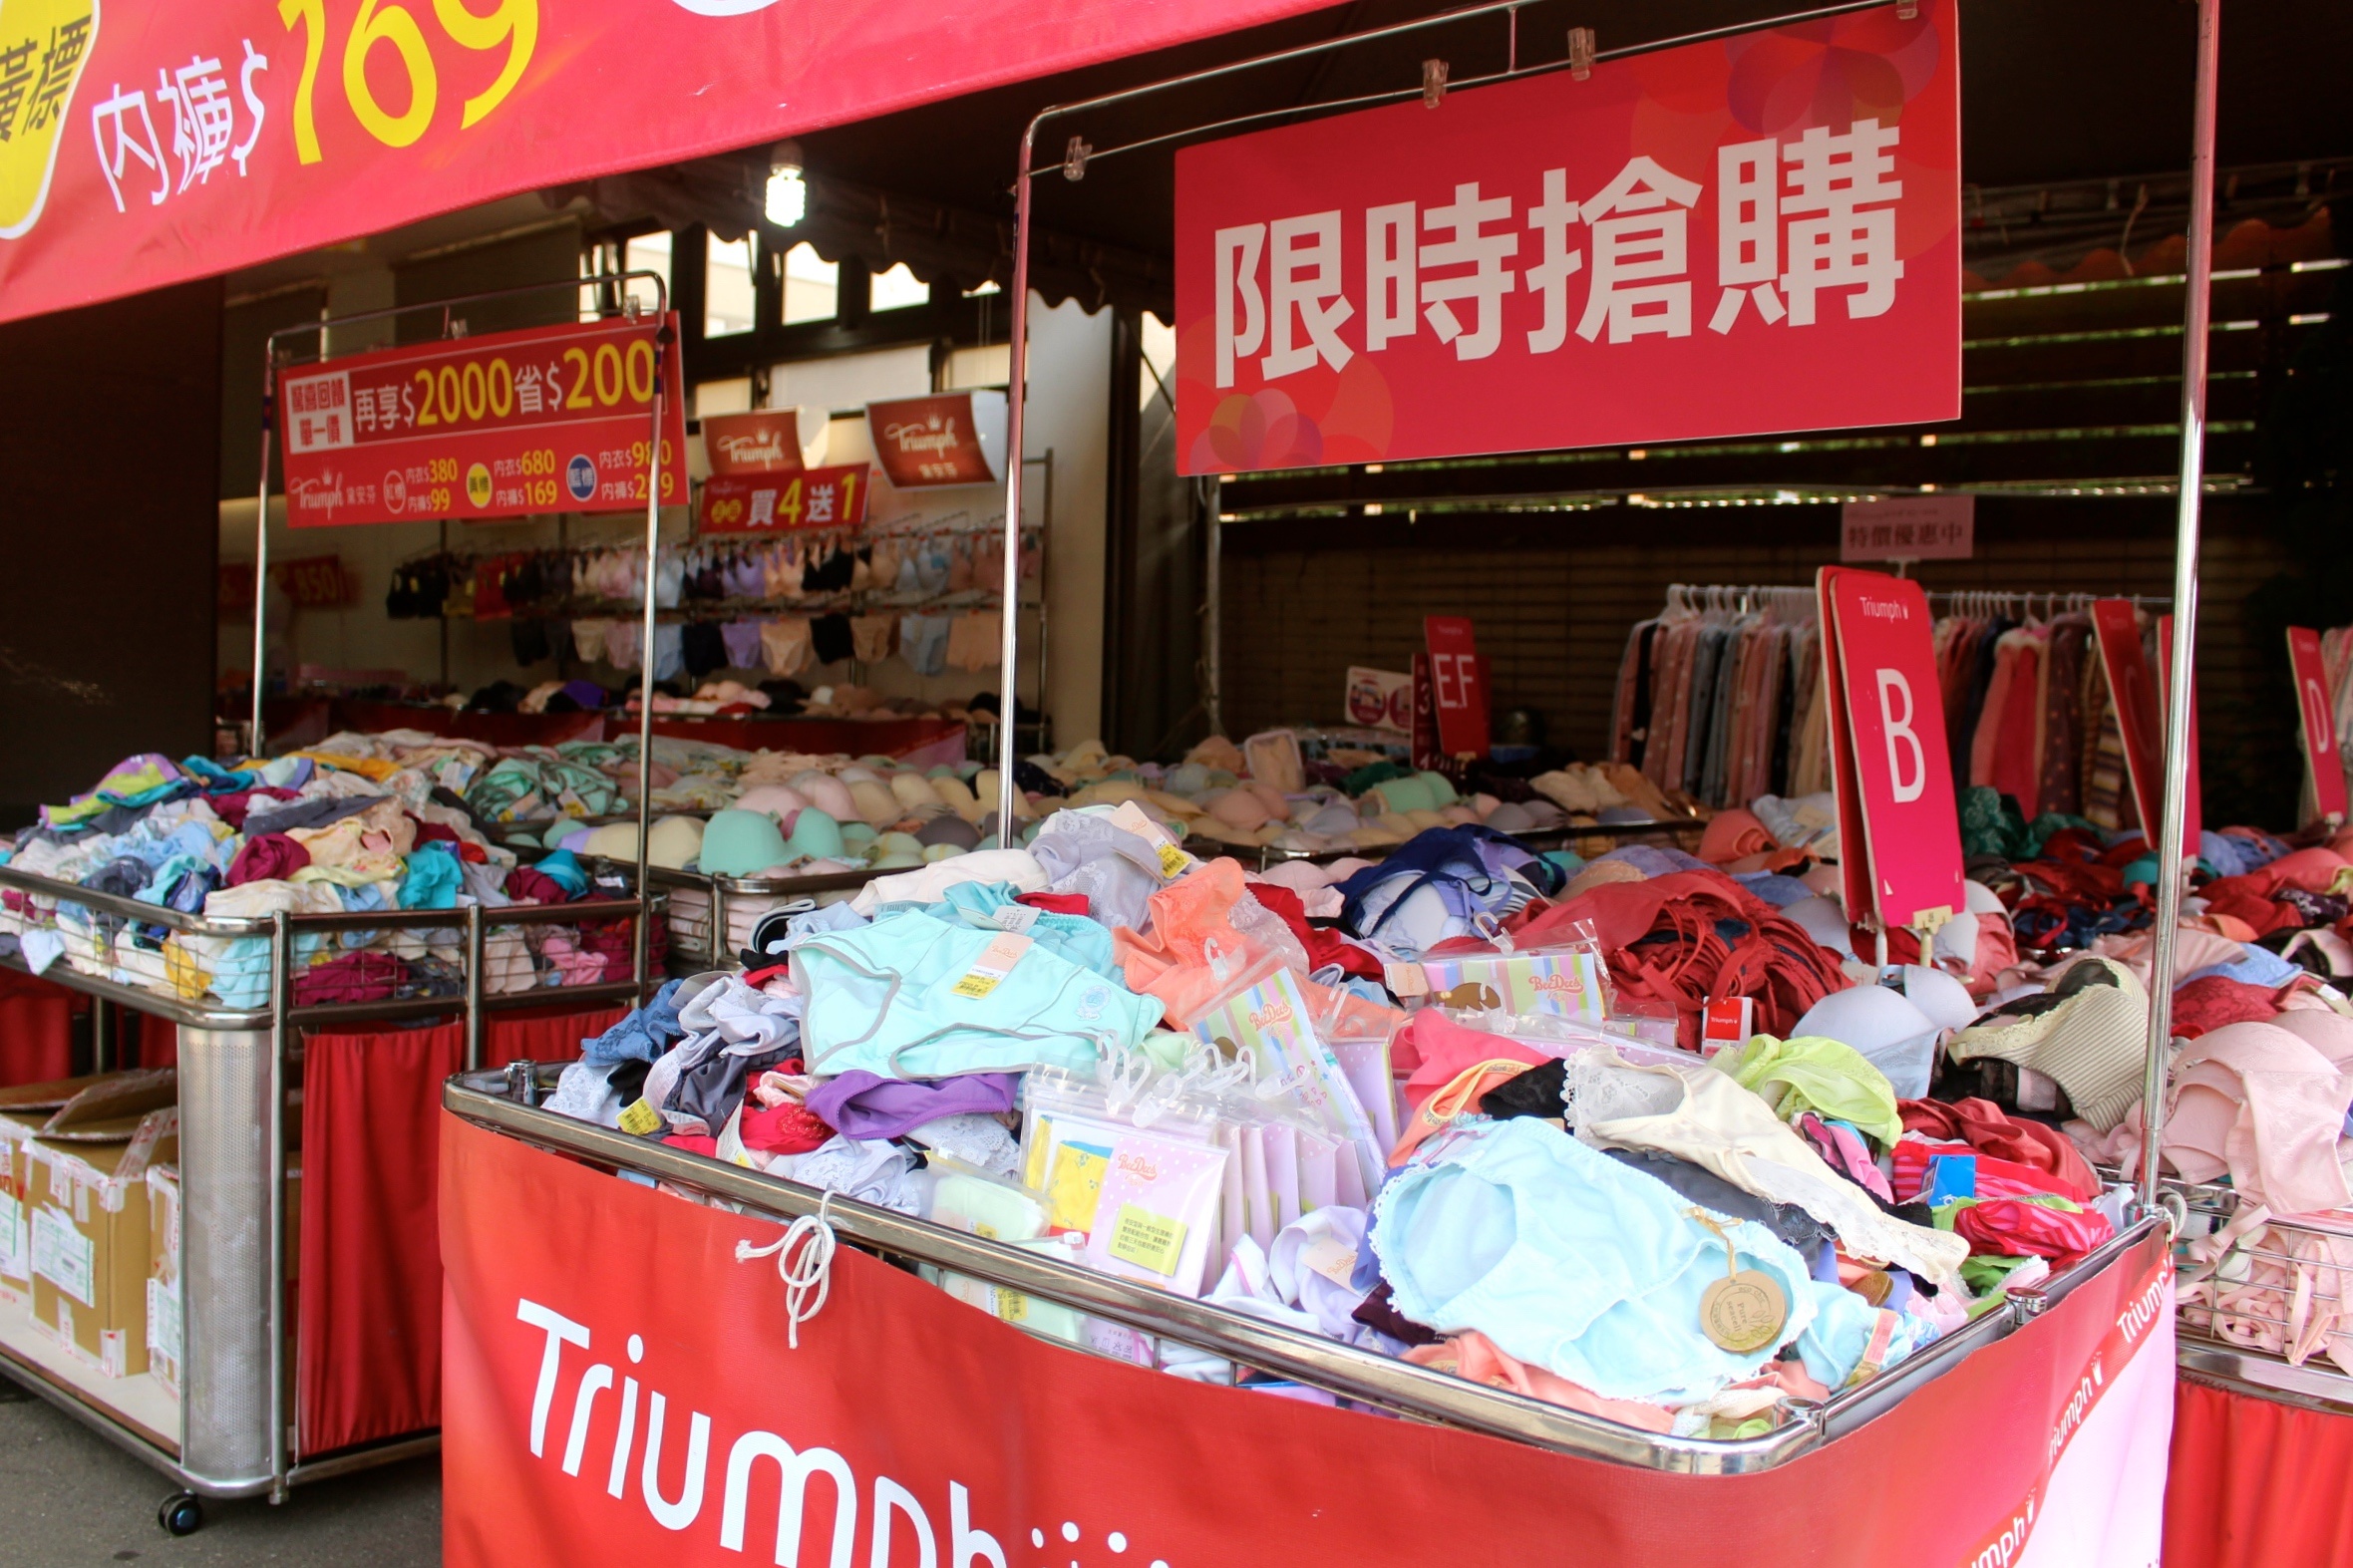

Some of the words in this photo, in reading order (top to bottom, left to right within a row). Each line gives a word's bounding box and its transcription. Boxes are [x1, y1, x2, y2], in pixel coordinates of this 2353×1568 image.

[1214, 119, 1904, 389] 限時搶購
[354, 339, 655, 433] 再享$2000省$200
[717, 431, 785, 471] Triumph
[883, 417, 958, 460] Triumph
[494, 449, 555, 477] 內衣$680
[289, 470, 343, 520] Triumph
[496, 479, 557, 508] 內褲$169
[601, 471, 674, 500] 內褲$29
[747, 473, 857, 528] 買4送1
[1849, 522, 1963, 548] 特價優惠中
[1859, 596, 1901, 623] Triumph
[1876, 668, 1925, 803] B
[2307, 678, 2329, 754] D
[1711, 1016, 1734, 1025] Triumph
[1737, 1301, 1748, 1325] Pure
